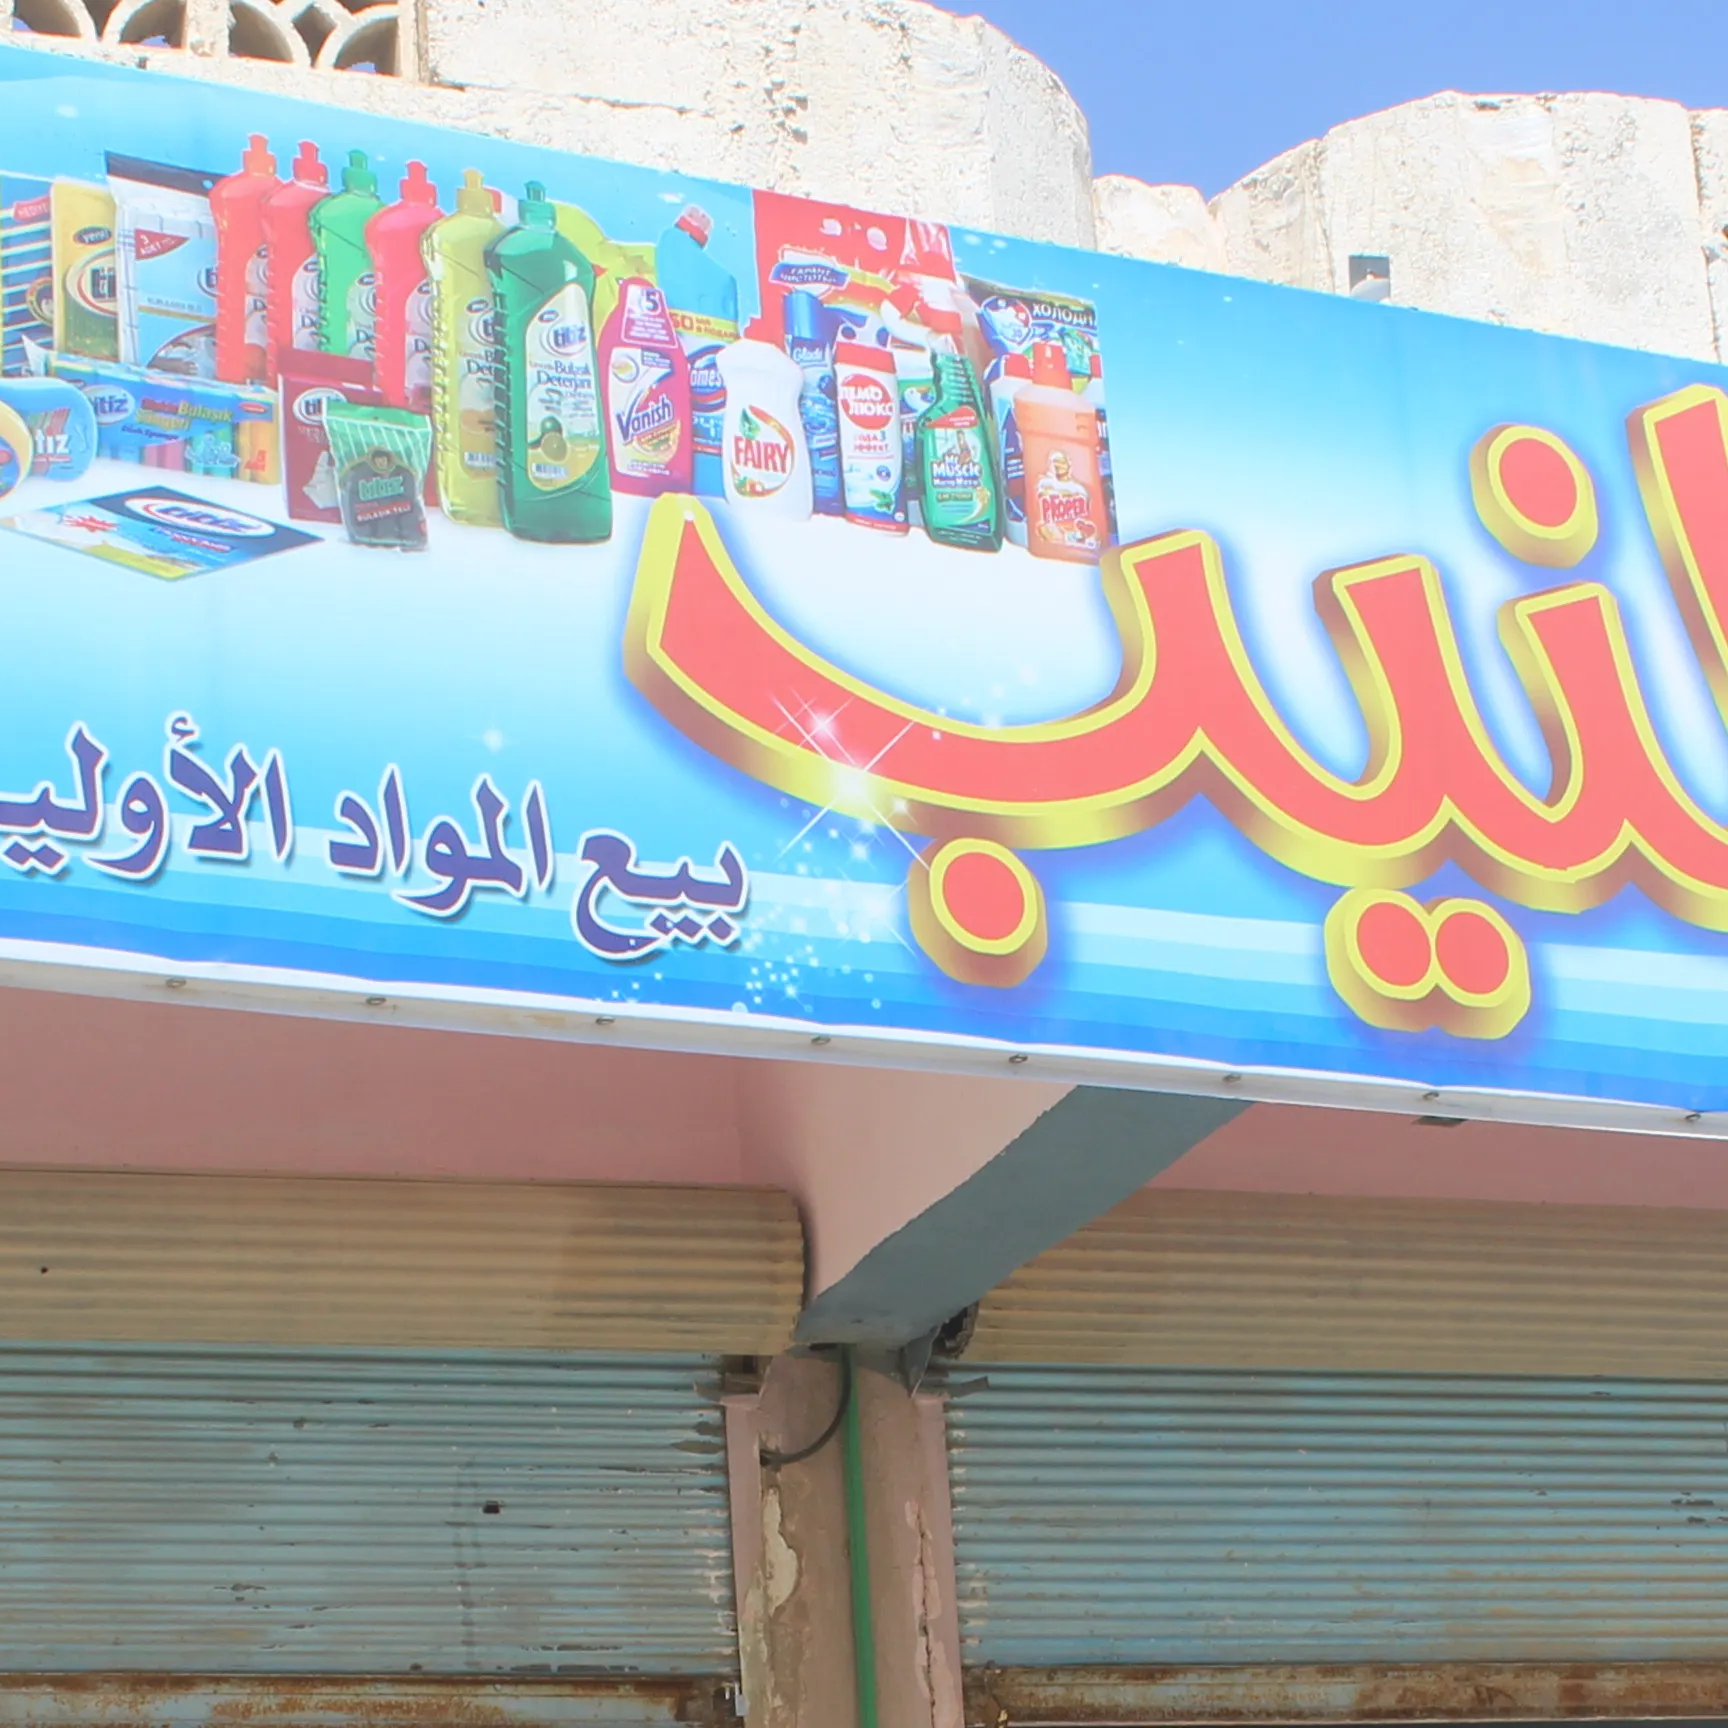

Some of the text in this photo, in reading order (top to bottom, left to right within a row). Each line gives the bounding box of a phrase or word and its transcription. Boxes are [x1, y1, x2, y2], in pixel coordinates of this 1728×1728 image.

[617, 395, 674, 444] Vanish
[733, 437, 790, 474] FAIRY
[327, 763, 553, 917] المواد
[573, 829, 750, 960] بيع
